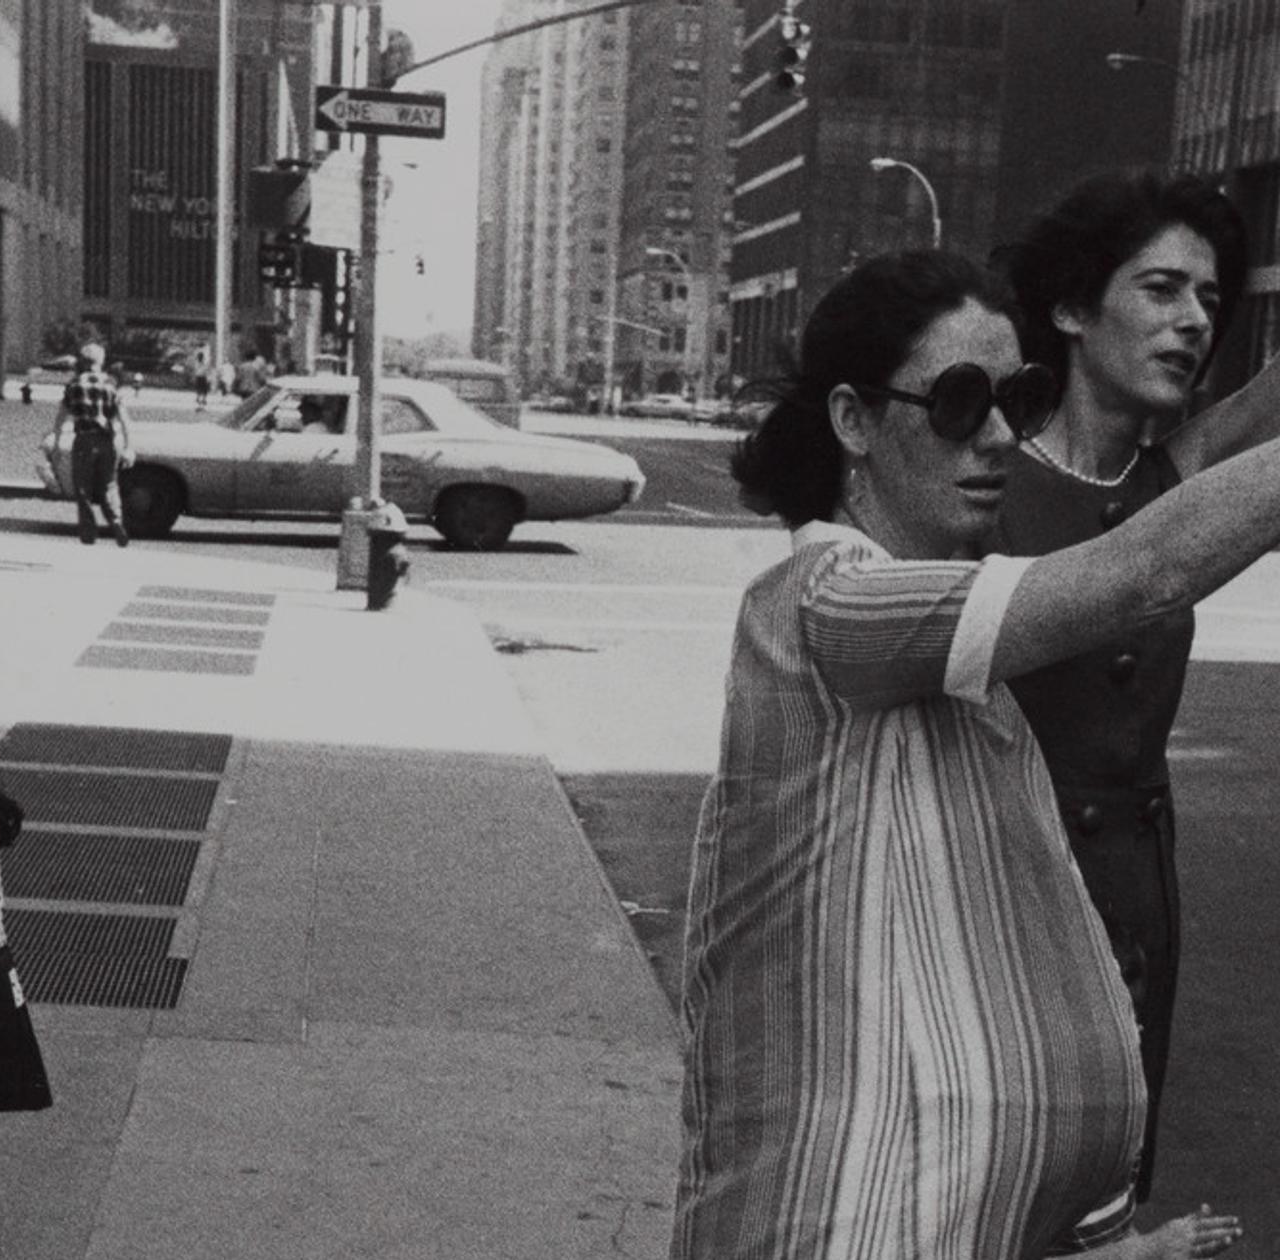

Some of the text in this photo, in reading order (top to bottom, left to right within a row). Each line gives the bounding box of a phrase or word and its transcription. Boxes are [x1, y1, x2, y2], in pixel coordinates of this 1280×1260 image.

[333, 100, 435, 125] ONE WAY
[131, 169, 168, 190] THE
[130, 193, 177, 213] NEW
